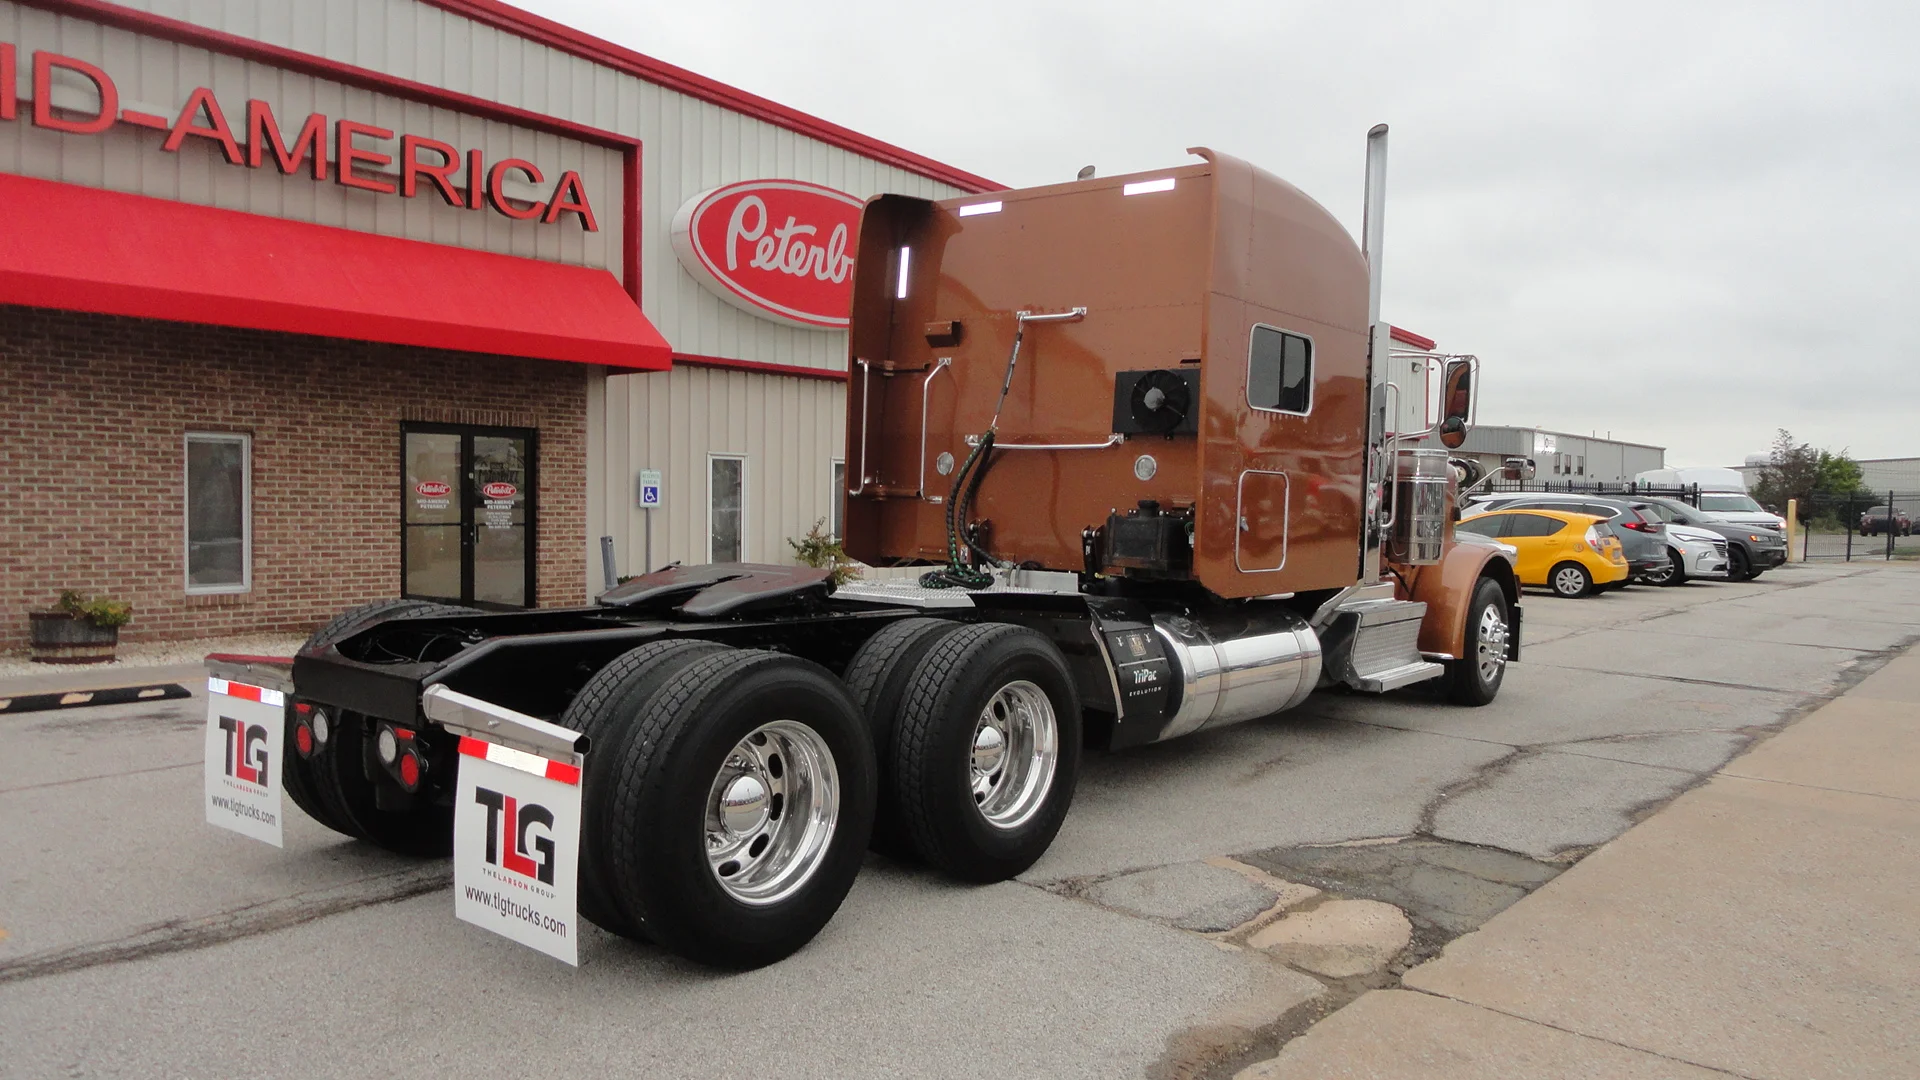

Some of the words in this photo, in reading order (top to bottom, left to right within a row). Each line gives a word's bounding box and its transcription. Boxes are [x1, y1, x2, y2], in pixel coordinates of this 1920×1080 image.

[726, 194, 854, 284] Peterb
[1129, 686, 1161, 697] EVOLUTION
[1133, 668, 1157, 684] TriPac
[219, 715, 268, 787] TLG
[211, 794, 276, 827] www.tlgtrucks.com
[475, 785, 554, 887] TLG
[464, 884, 567, 938] www.tlgtrucks.com
[530, 885, 555, 899] GROUP
